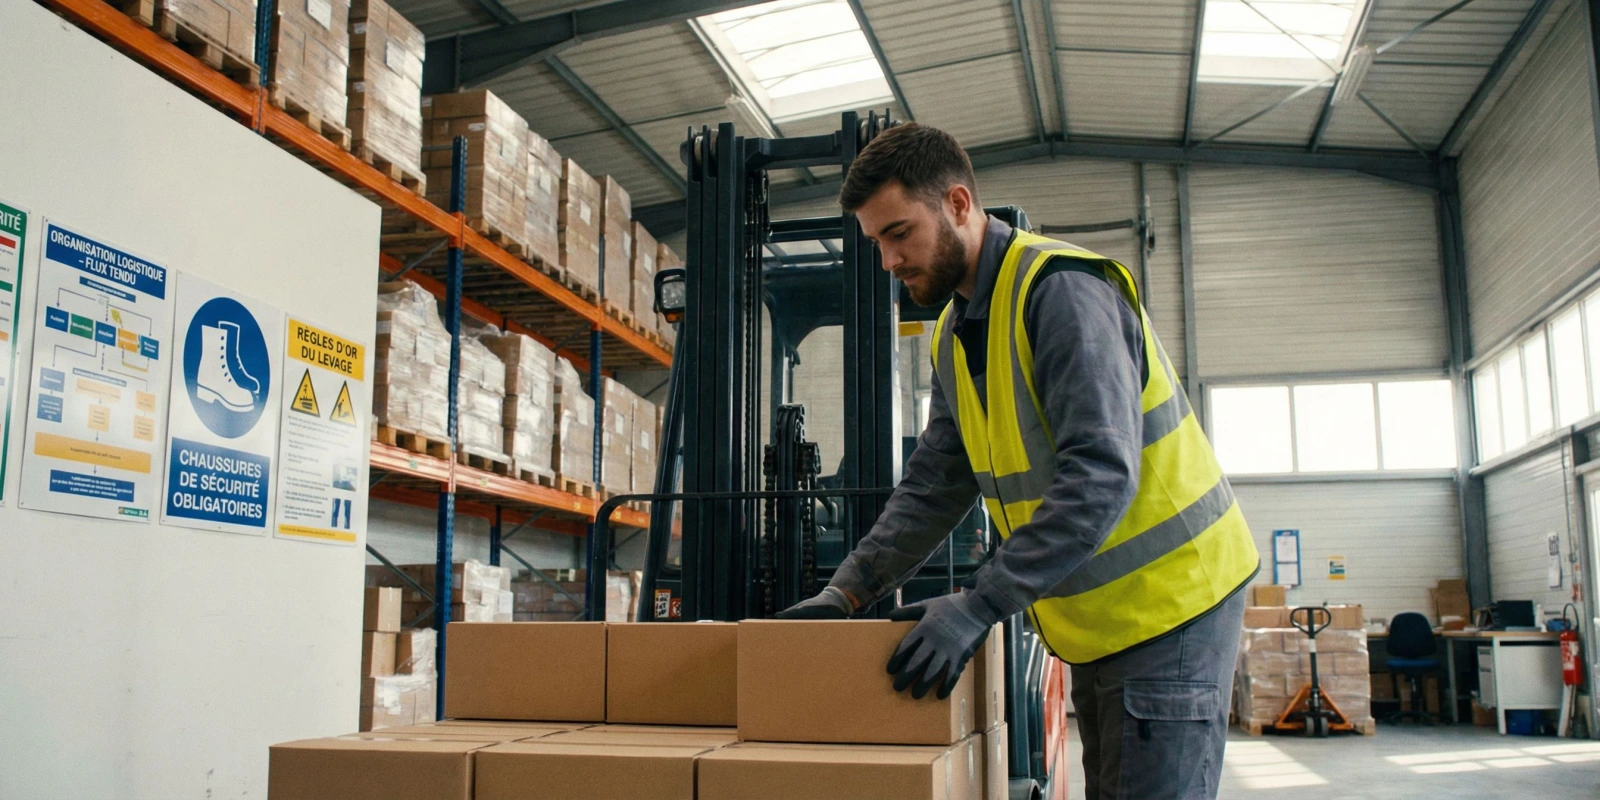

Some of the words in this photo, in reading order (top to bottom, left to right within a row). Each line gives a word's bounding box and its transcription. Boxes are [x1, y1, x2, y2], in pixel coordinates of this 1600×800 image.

[51, 230, 116, 264] ORGANISATION
[117, 255, 164, 282] LOGISTIQUE
[85, 257, 107, 275] FLUX
[109, 265, 136, 285] TENDU
[297, 325, 334, 351] RÈGLES
[301, 345, 316, 361] DU
[318, 350, 353, 374] LEVAGE
[179, 449, 262, 478] CHAUSSURES
[180, 471, 198, 488] DE
[200, 472, 260, 498] SÉCURITÉ
[173, 492, 263, 519] OBLIGATOIRES
